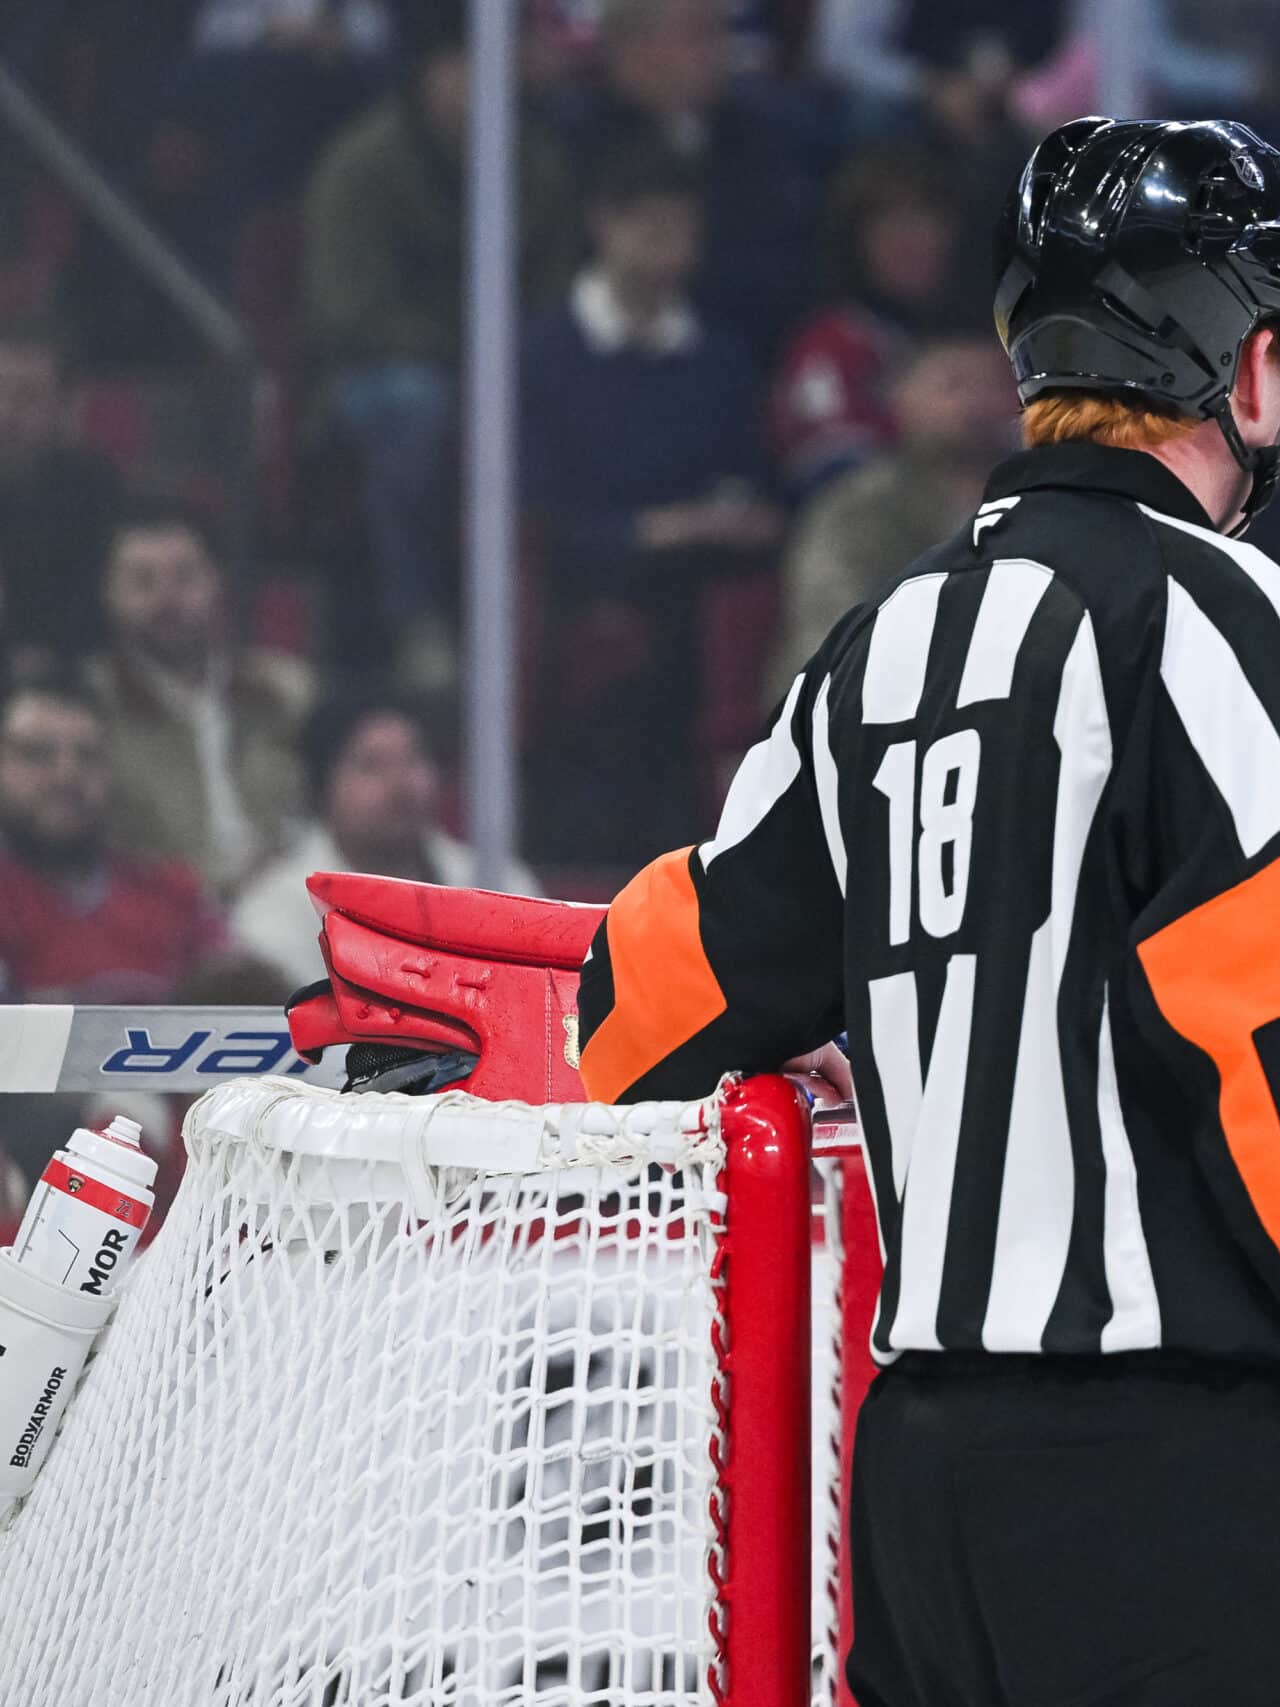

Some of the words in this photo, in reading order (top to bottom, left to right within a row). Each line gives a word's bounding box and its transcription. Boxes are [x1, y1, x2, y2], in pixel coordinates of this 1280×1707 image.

[871, 728, 981, 947] 18
[100, 1029, 310, 1074] ER
[115, 1199, 133, 1217] 72
[9, 1366, 67, 1467] BODYARMOR
